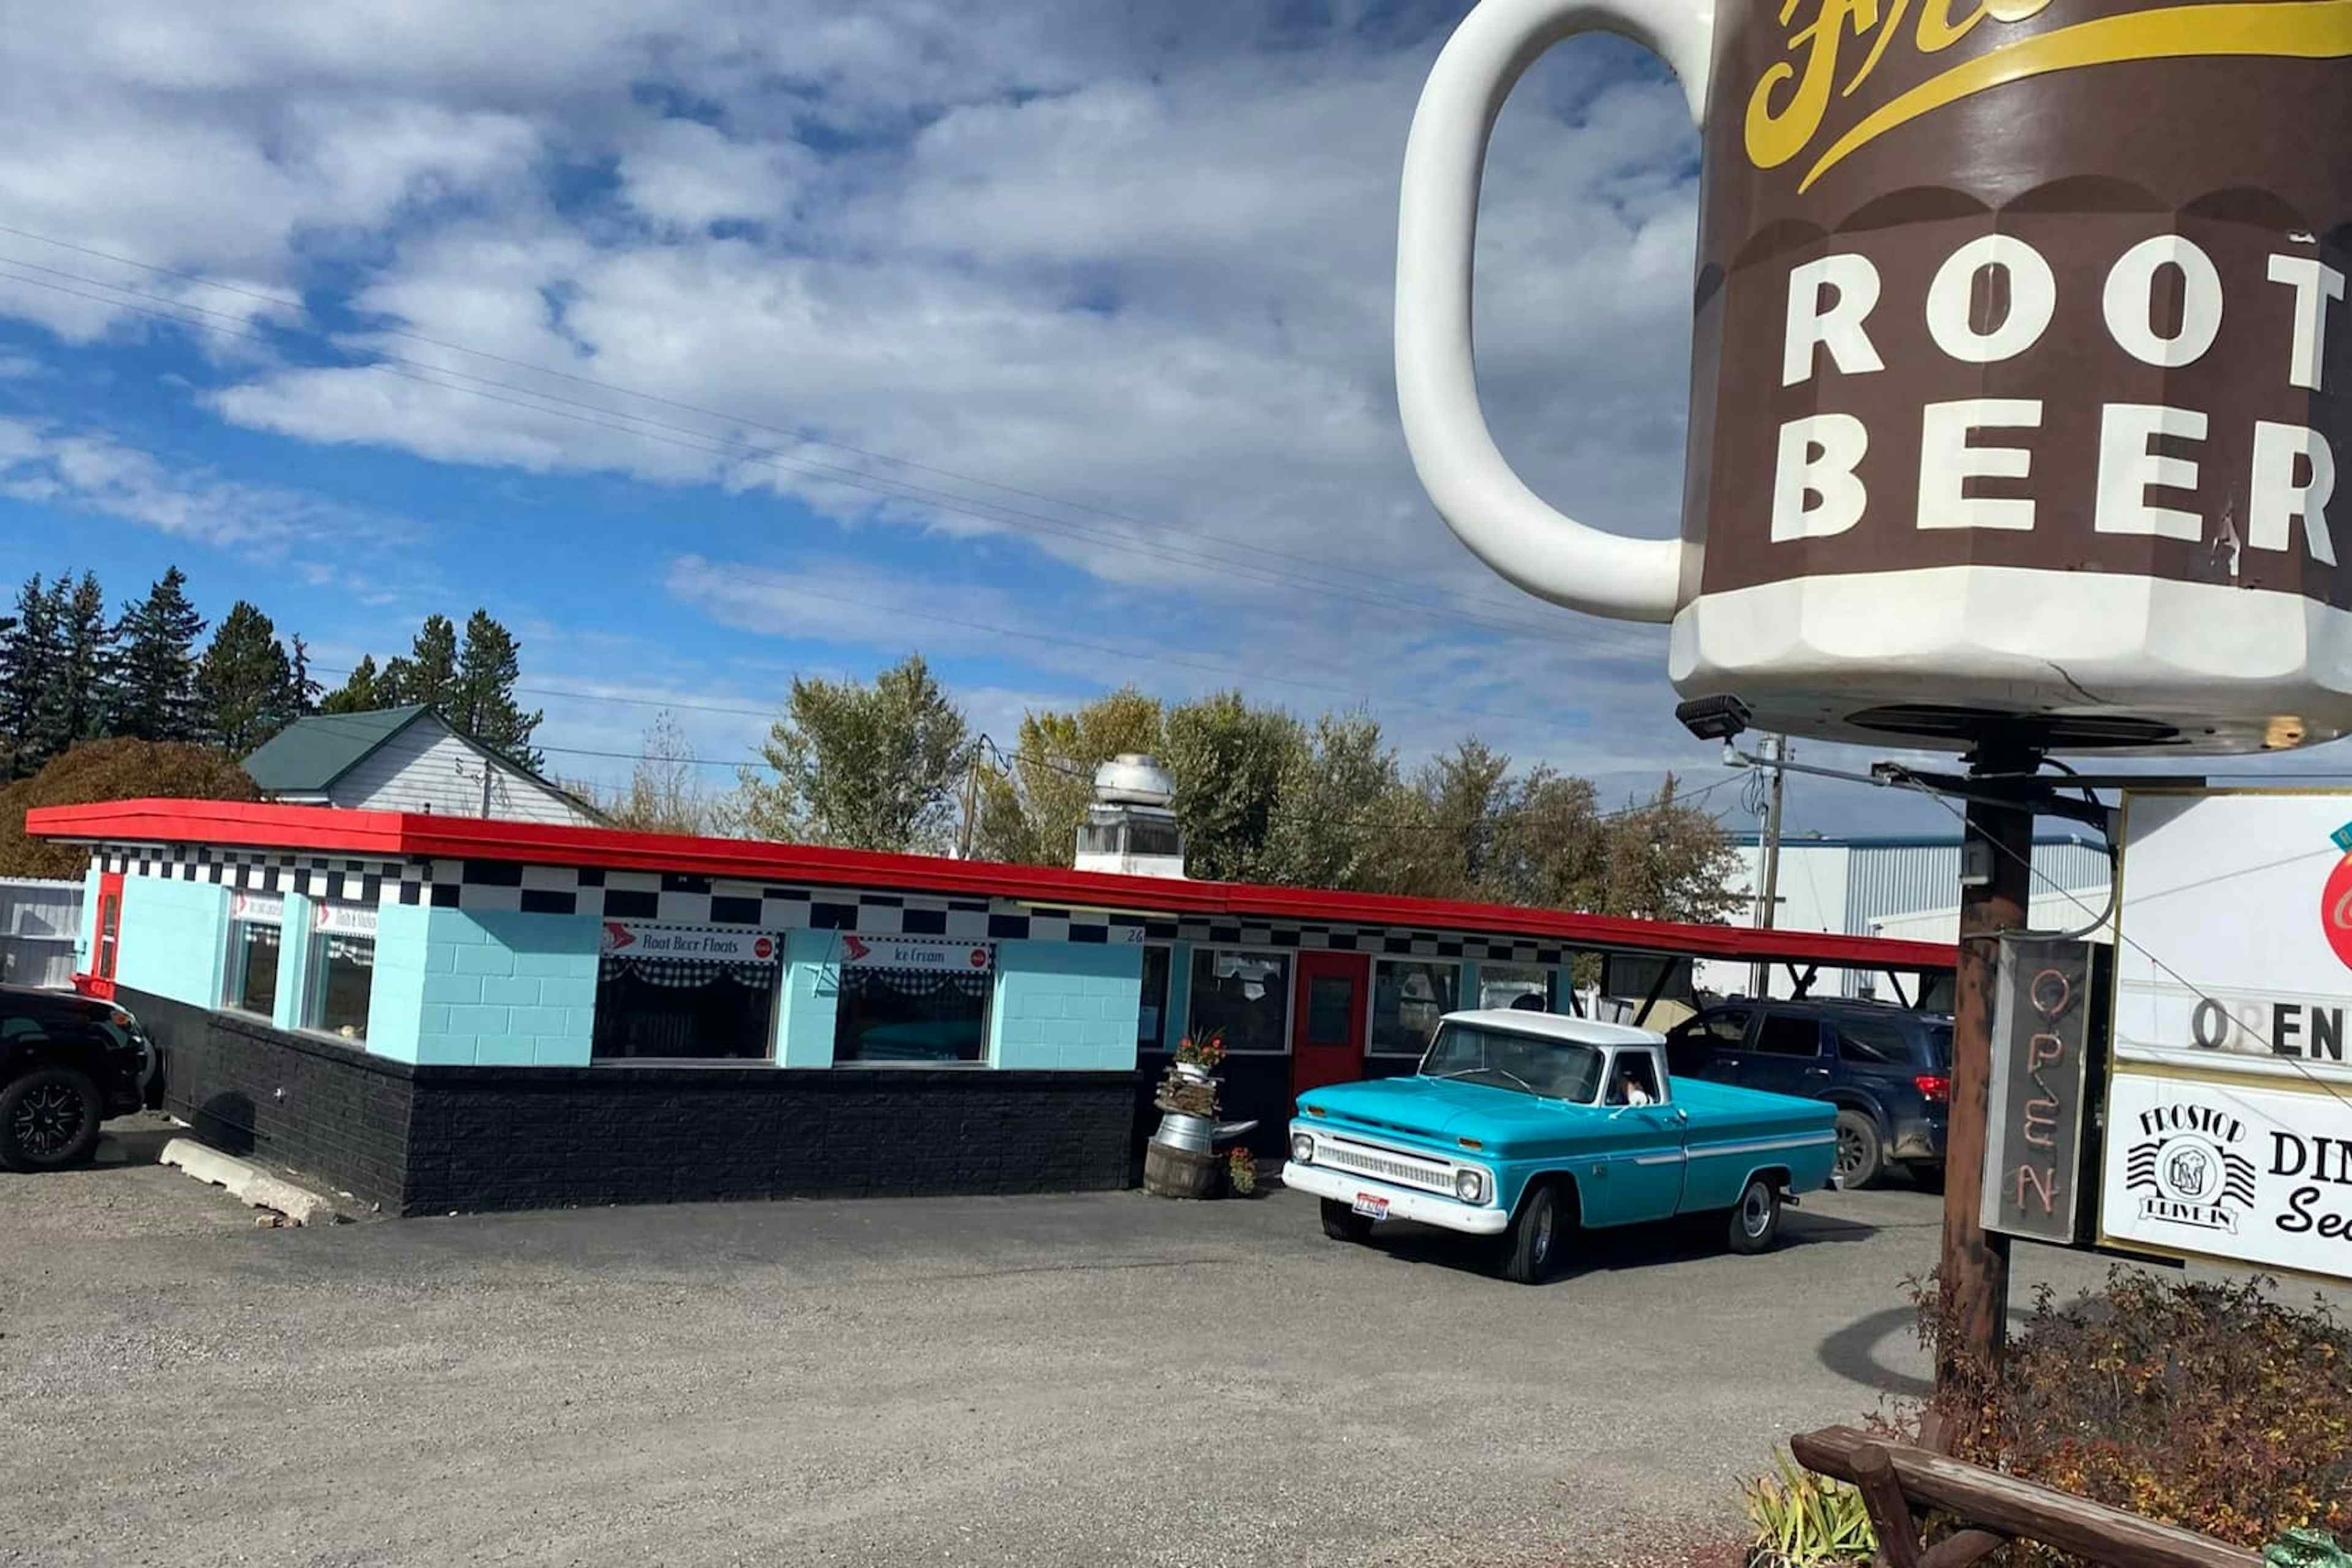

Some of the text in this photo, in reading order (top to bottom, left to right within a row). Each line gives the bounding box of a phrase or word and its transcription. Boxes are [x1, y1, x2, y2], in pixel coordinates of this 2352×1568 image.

[1781, 233, 2345, 391] ROOT
[1770, 398, 2338, 568] BEER
[643, 934, 670, 950] Root
[673, 936, 699, 951] Beer
[703, 938, 738, 954] Floats
[894, 947, 946, 963] Ice Cream
[2192, 997, 2343, 1060] OPEN
[2016, 968, 2071, 1215] OPEN
[2139, 1103, 2247, 1143] FROSTOP
